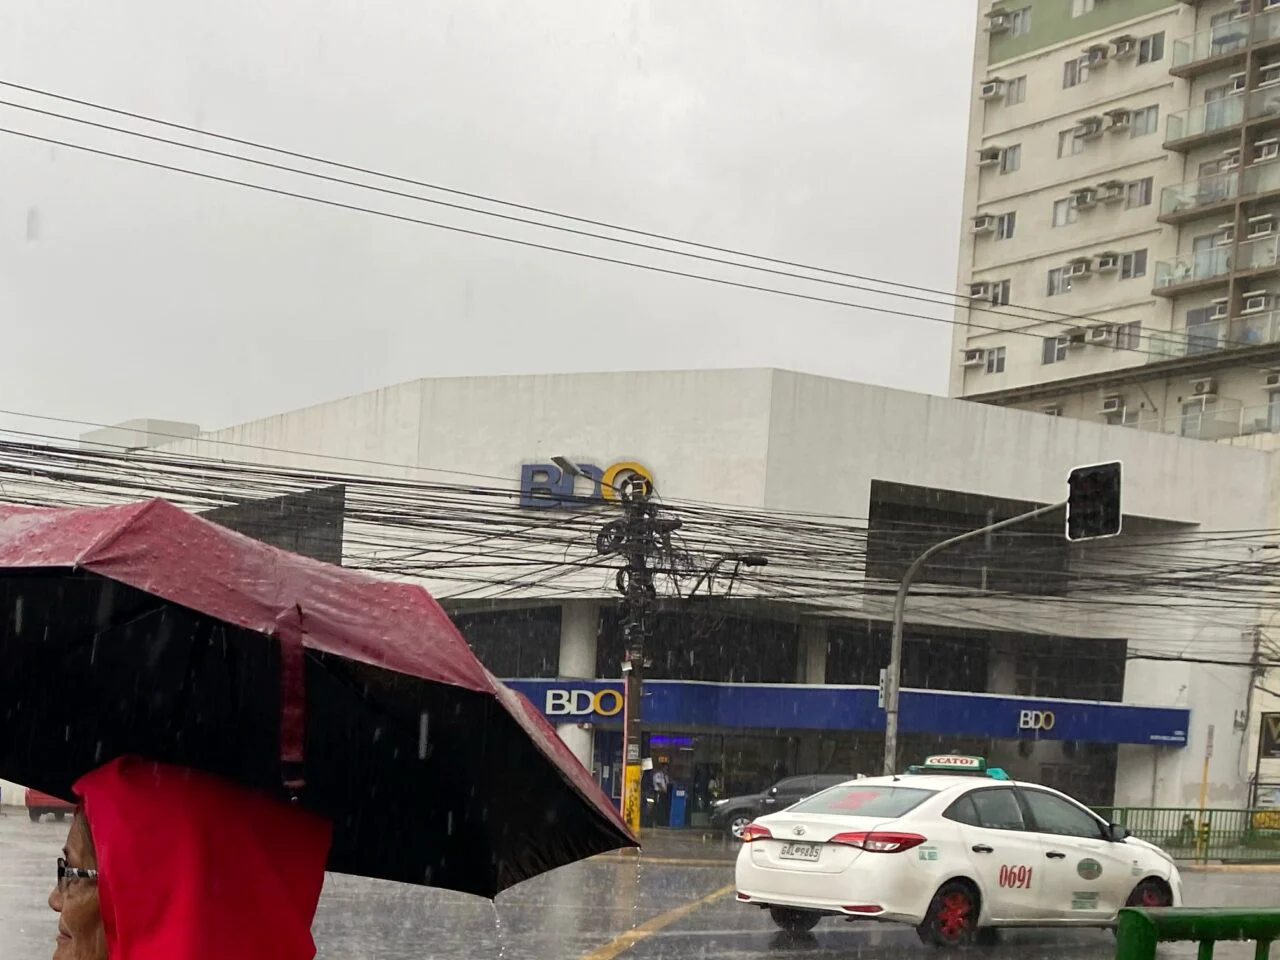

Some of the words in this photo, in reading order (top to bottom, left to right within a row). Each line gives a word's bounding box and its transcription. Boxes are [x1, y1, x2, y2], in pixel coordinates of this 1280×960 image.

[520, 461, 654, 510] BDO
[545, 689, 624, 716] BDO
[1019, 709, 1055, 731] BDO
[999, 863, 1033, 889] 0691
